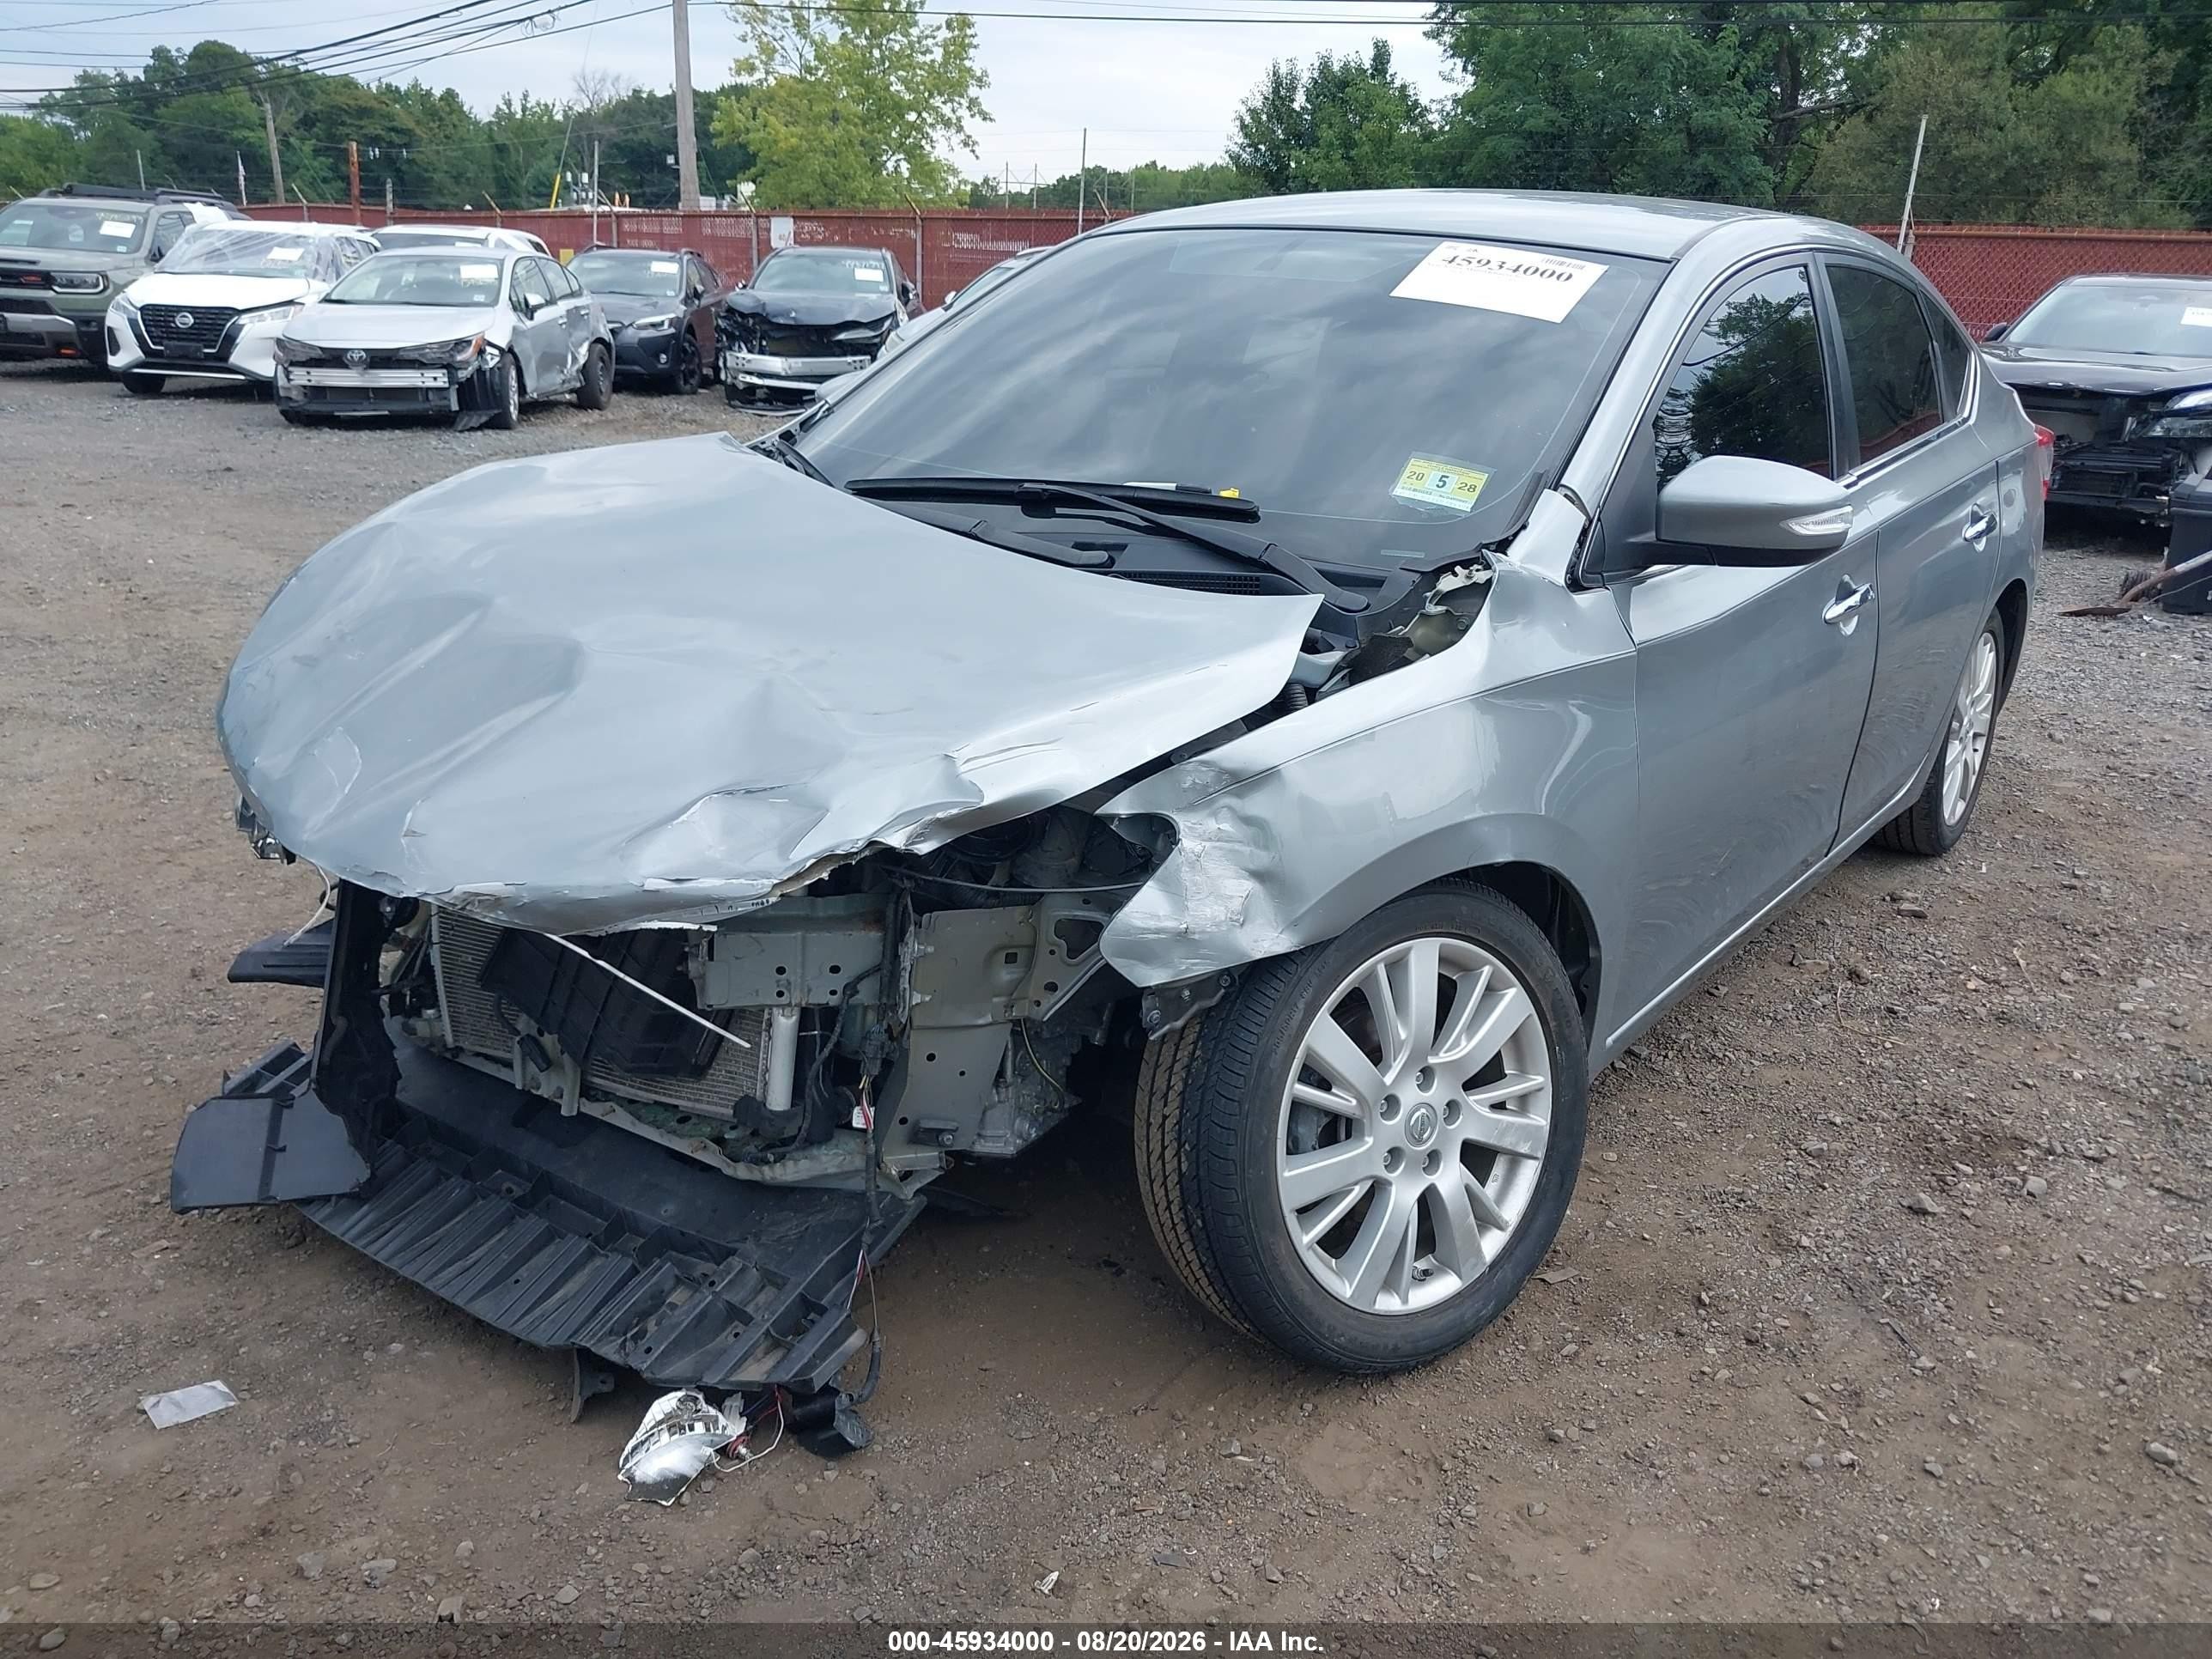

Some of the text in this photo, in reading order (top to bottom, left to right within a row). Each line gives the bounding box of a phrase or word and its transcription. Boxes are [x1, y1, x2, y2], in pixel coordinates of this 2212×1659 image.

[1442, 254, 1573, 283] 45934000
[1407, 471, 1477, 493] 20 5 28
